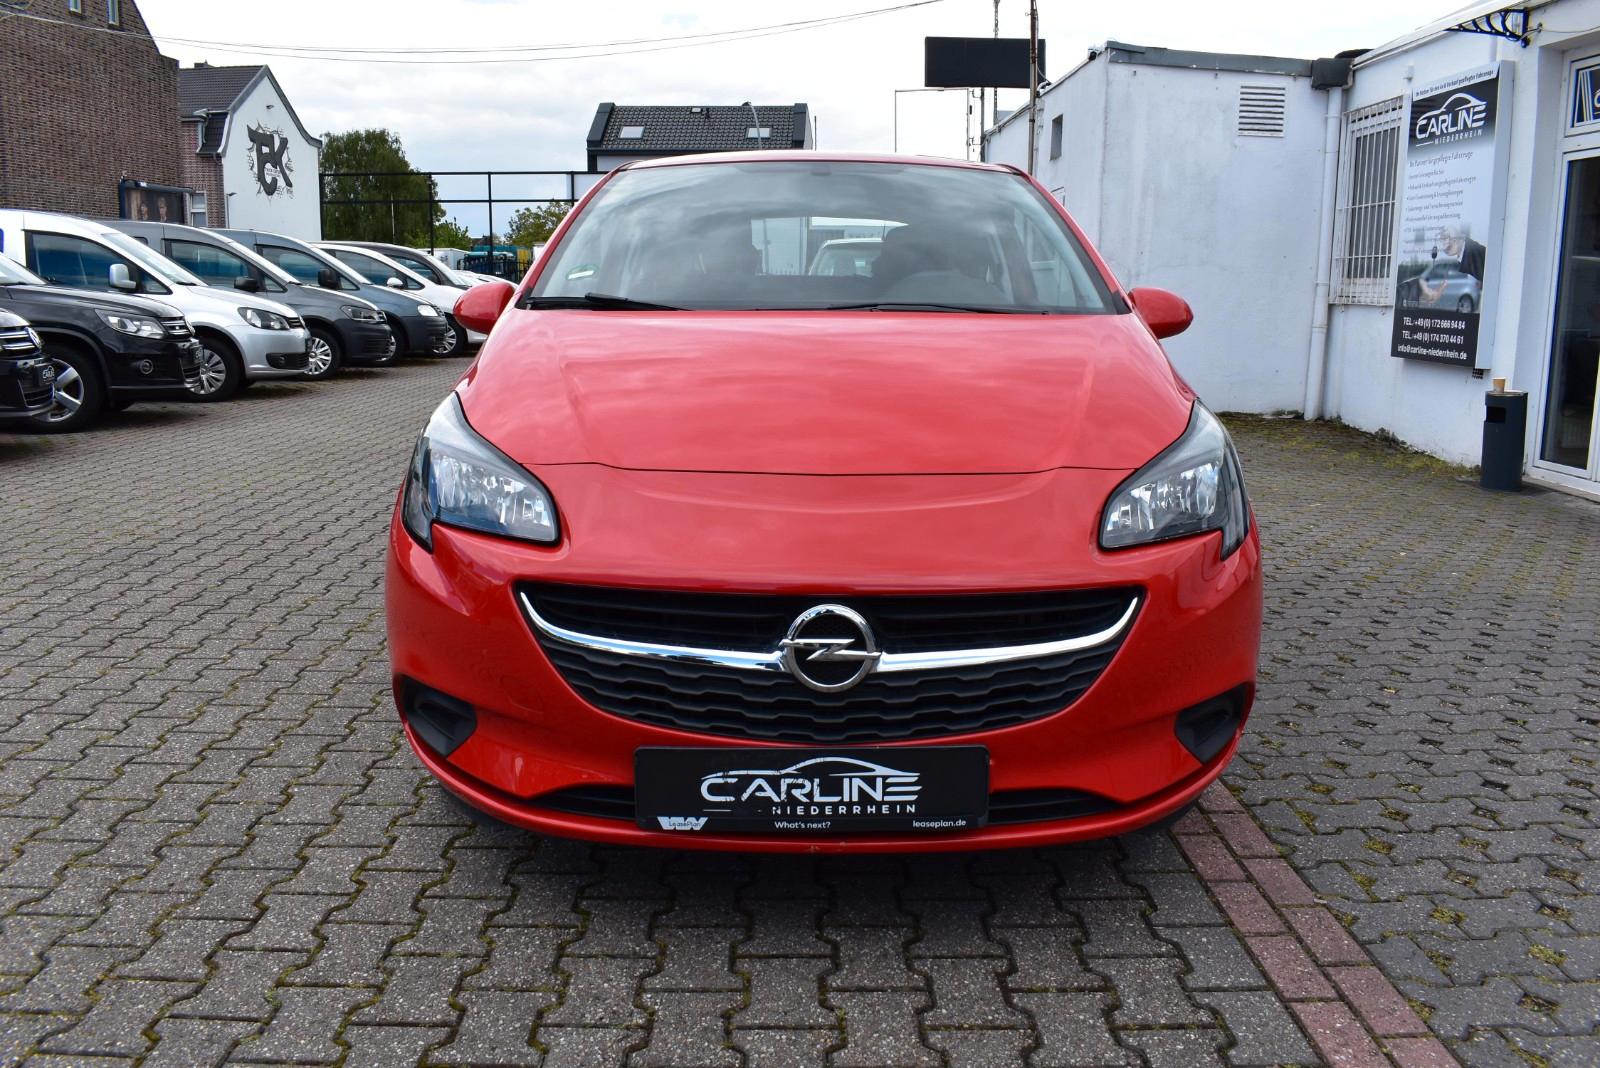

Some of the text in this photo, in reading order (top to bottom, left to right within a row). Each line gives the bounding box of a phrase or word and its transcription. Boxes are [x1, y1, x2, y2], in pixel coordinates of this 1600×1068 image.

[1416, 105, 1486, 139] CARLINE
[1450, 335, 1457, 343] 44
[700, 777, 922, 802] CARLINE
[772, 804, 916, 815] NIEDERRHEIN
[774, 821, 831, 829] What's next?
[912, 819, 967, 829] leaseplan.de
